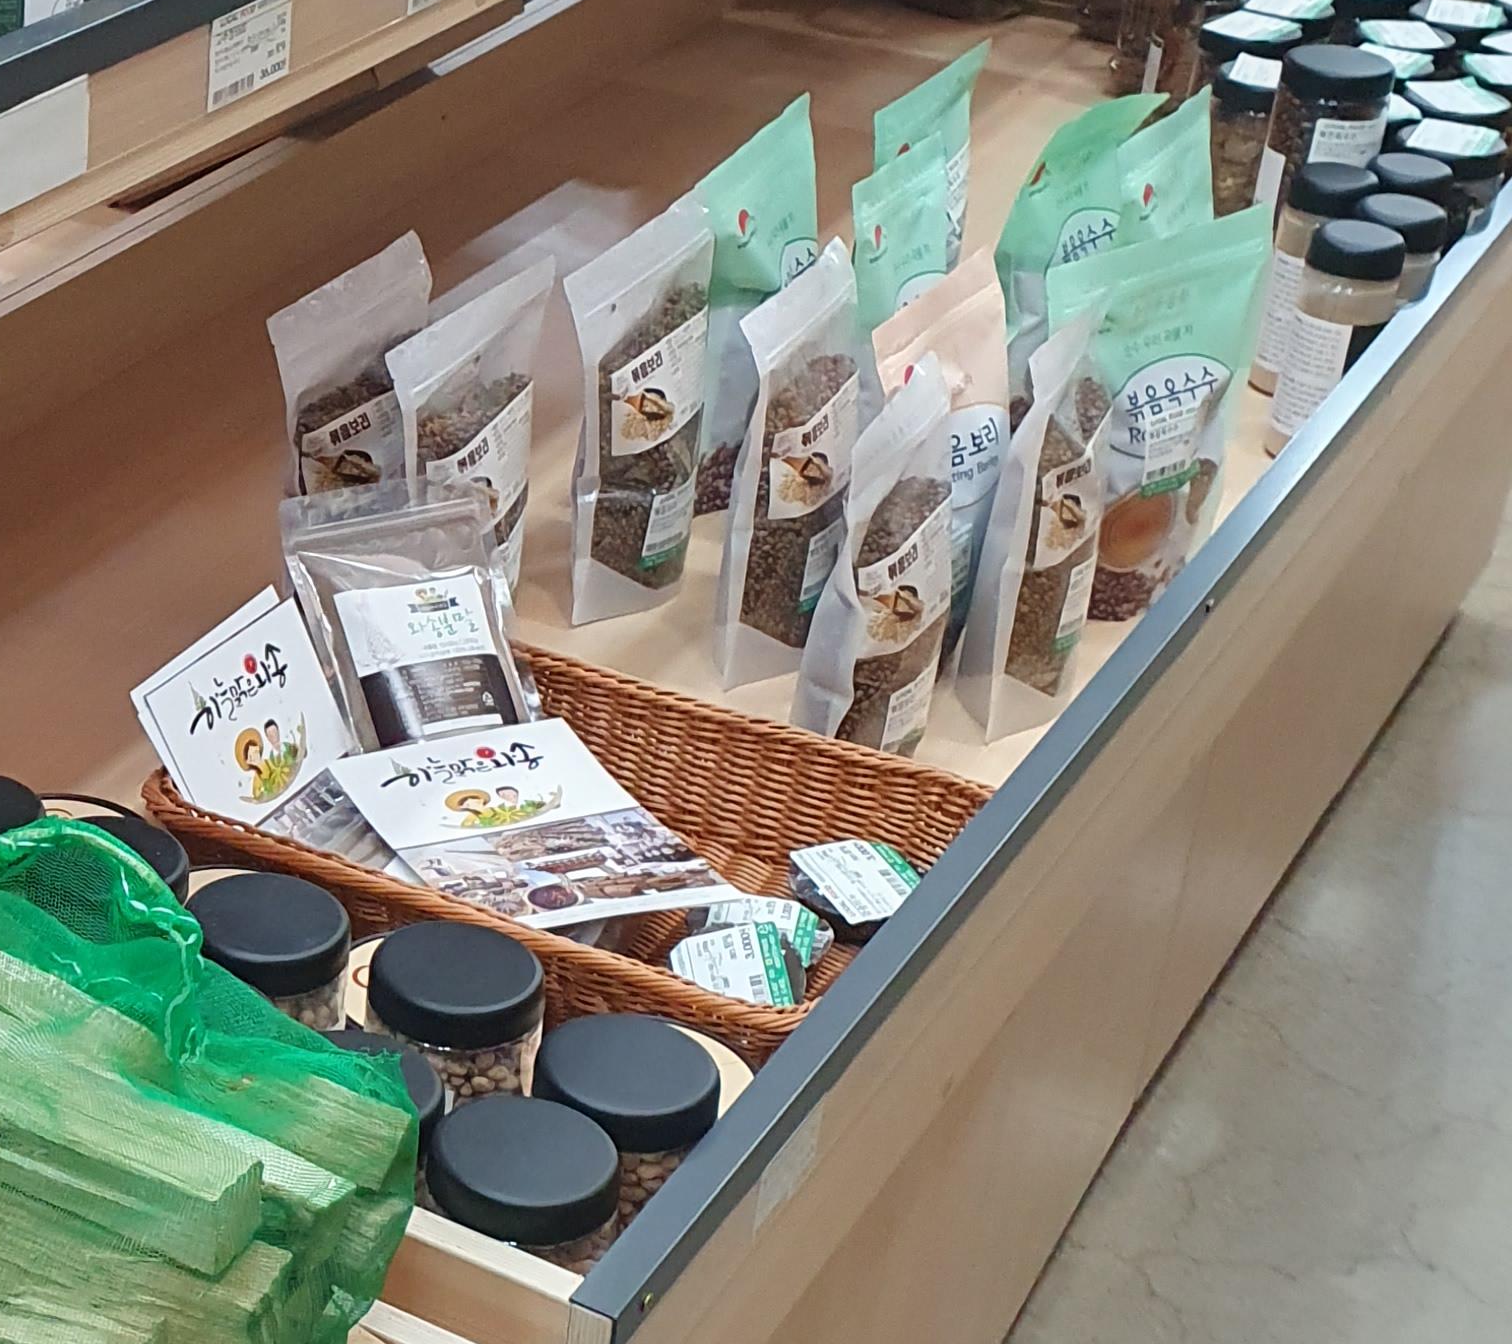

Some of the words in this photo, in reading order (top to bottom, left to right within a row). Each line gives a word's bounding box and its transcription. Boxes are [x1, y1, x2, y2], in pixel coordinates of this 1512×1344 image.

[631, 350, 664, 385] 볶음보리
[1126, 365, 1219, 424] 볶음옥수수
[329, 412, 372, 446] 볶음보리
[951, 416, 1000, 468] 음보리
[456, 436, 490, 474] 볶음보리
[407, 610, 480, 638] 와송분말
